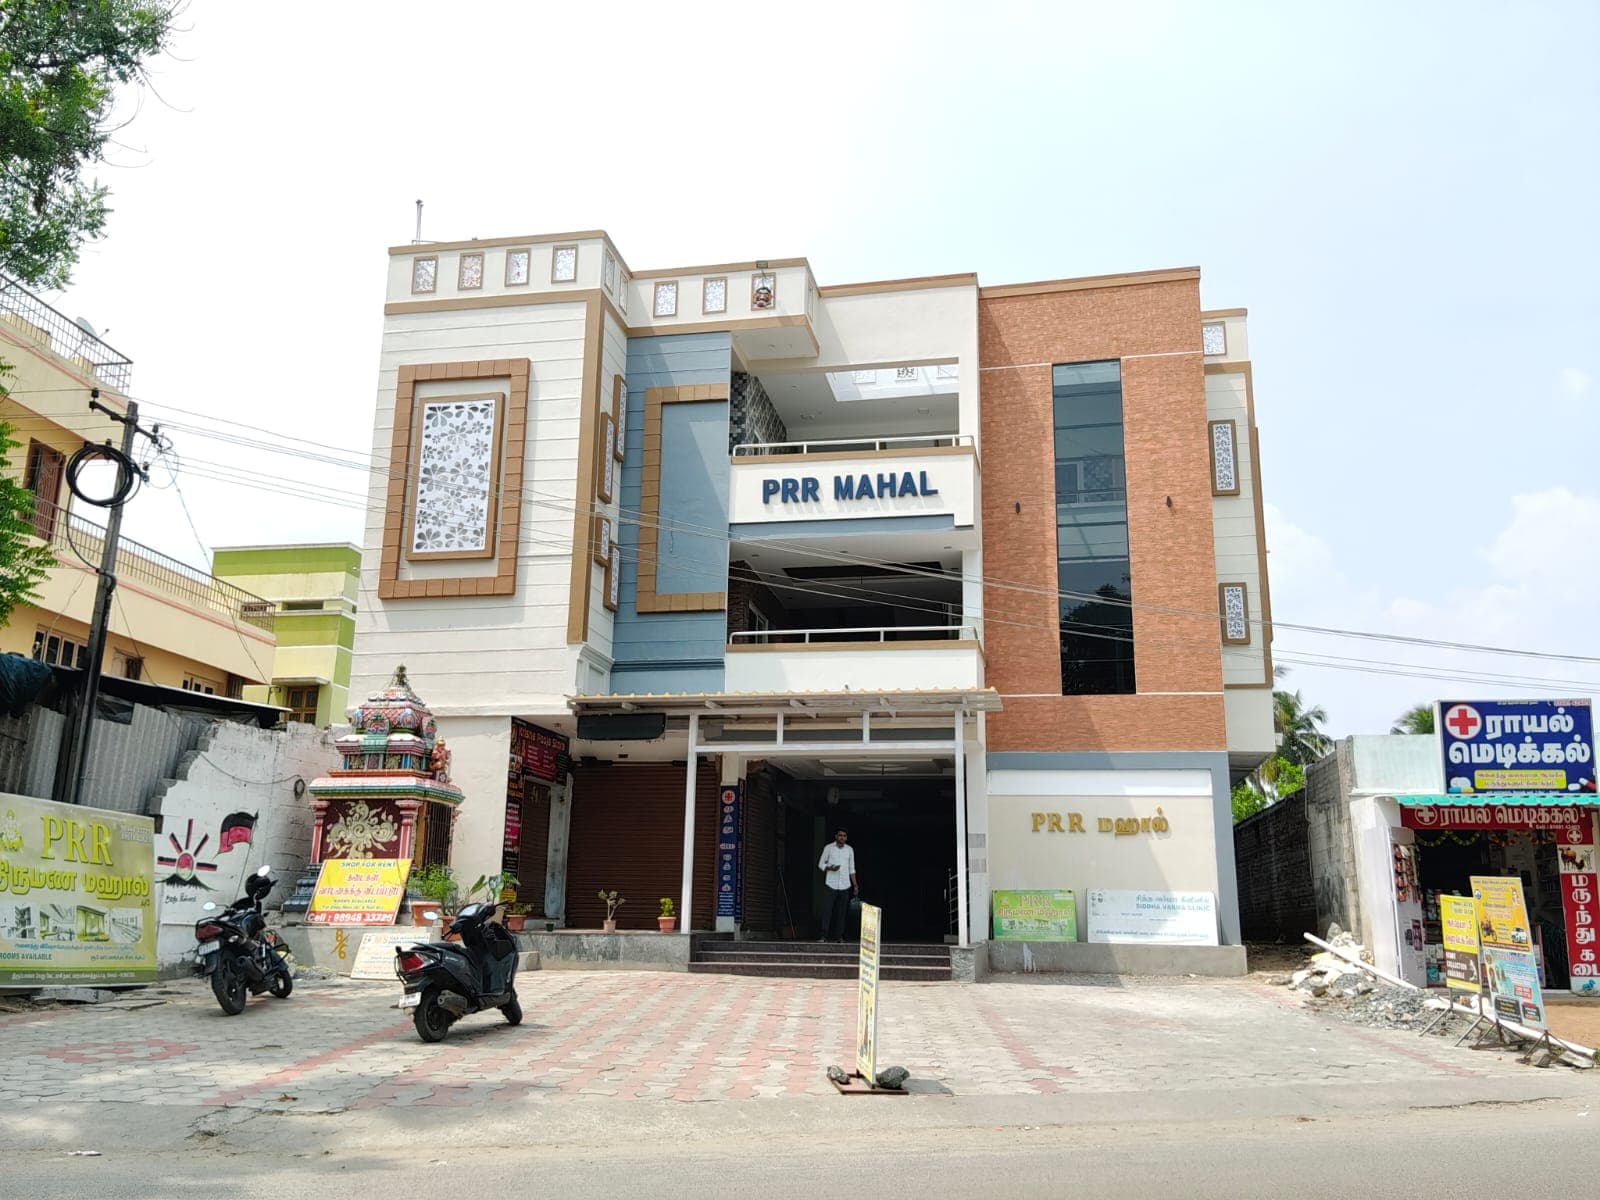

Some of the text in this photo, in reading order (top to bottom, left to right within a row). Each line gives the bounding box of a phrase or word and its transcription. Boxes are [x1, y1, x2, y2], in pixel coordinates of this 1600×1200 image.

[762, 470, 939, 504] PRR MAHAL
[1485, 707, 1574, 740] ராயல்
[1449, 734, 1591, 769] மெடிக்கல்
[1031, 806, 1169, 836] PRR மஹால்
[40, 815, 114, 867] PRR
[84, 873, 150, 900] மஹால்
[308, 913, 326, 921] Cell
